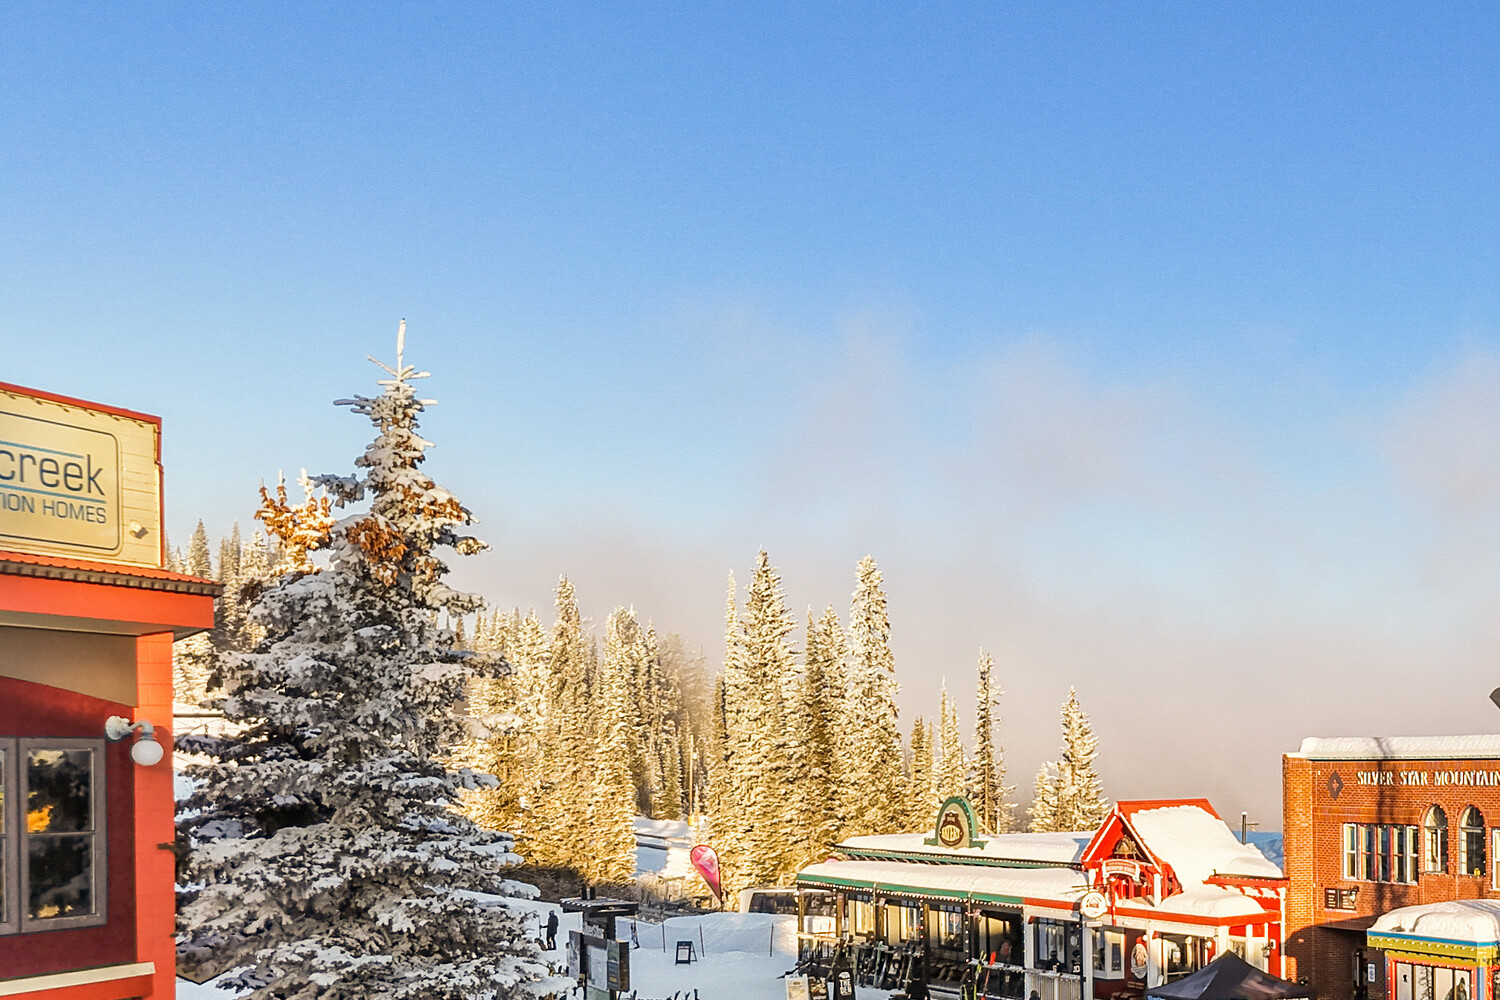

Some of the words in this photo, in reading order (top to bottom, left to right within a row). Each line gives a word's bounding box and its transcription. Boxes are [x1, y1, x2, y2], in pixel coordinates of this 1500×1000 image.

[0, 449, 105, 496] creek
[42, 499, 107, 524] HOMES
[1357, 770, 1394, 786] SILVER
[1400, 770, 1428, 786] STAR
